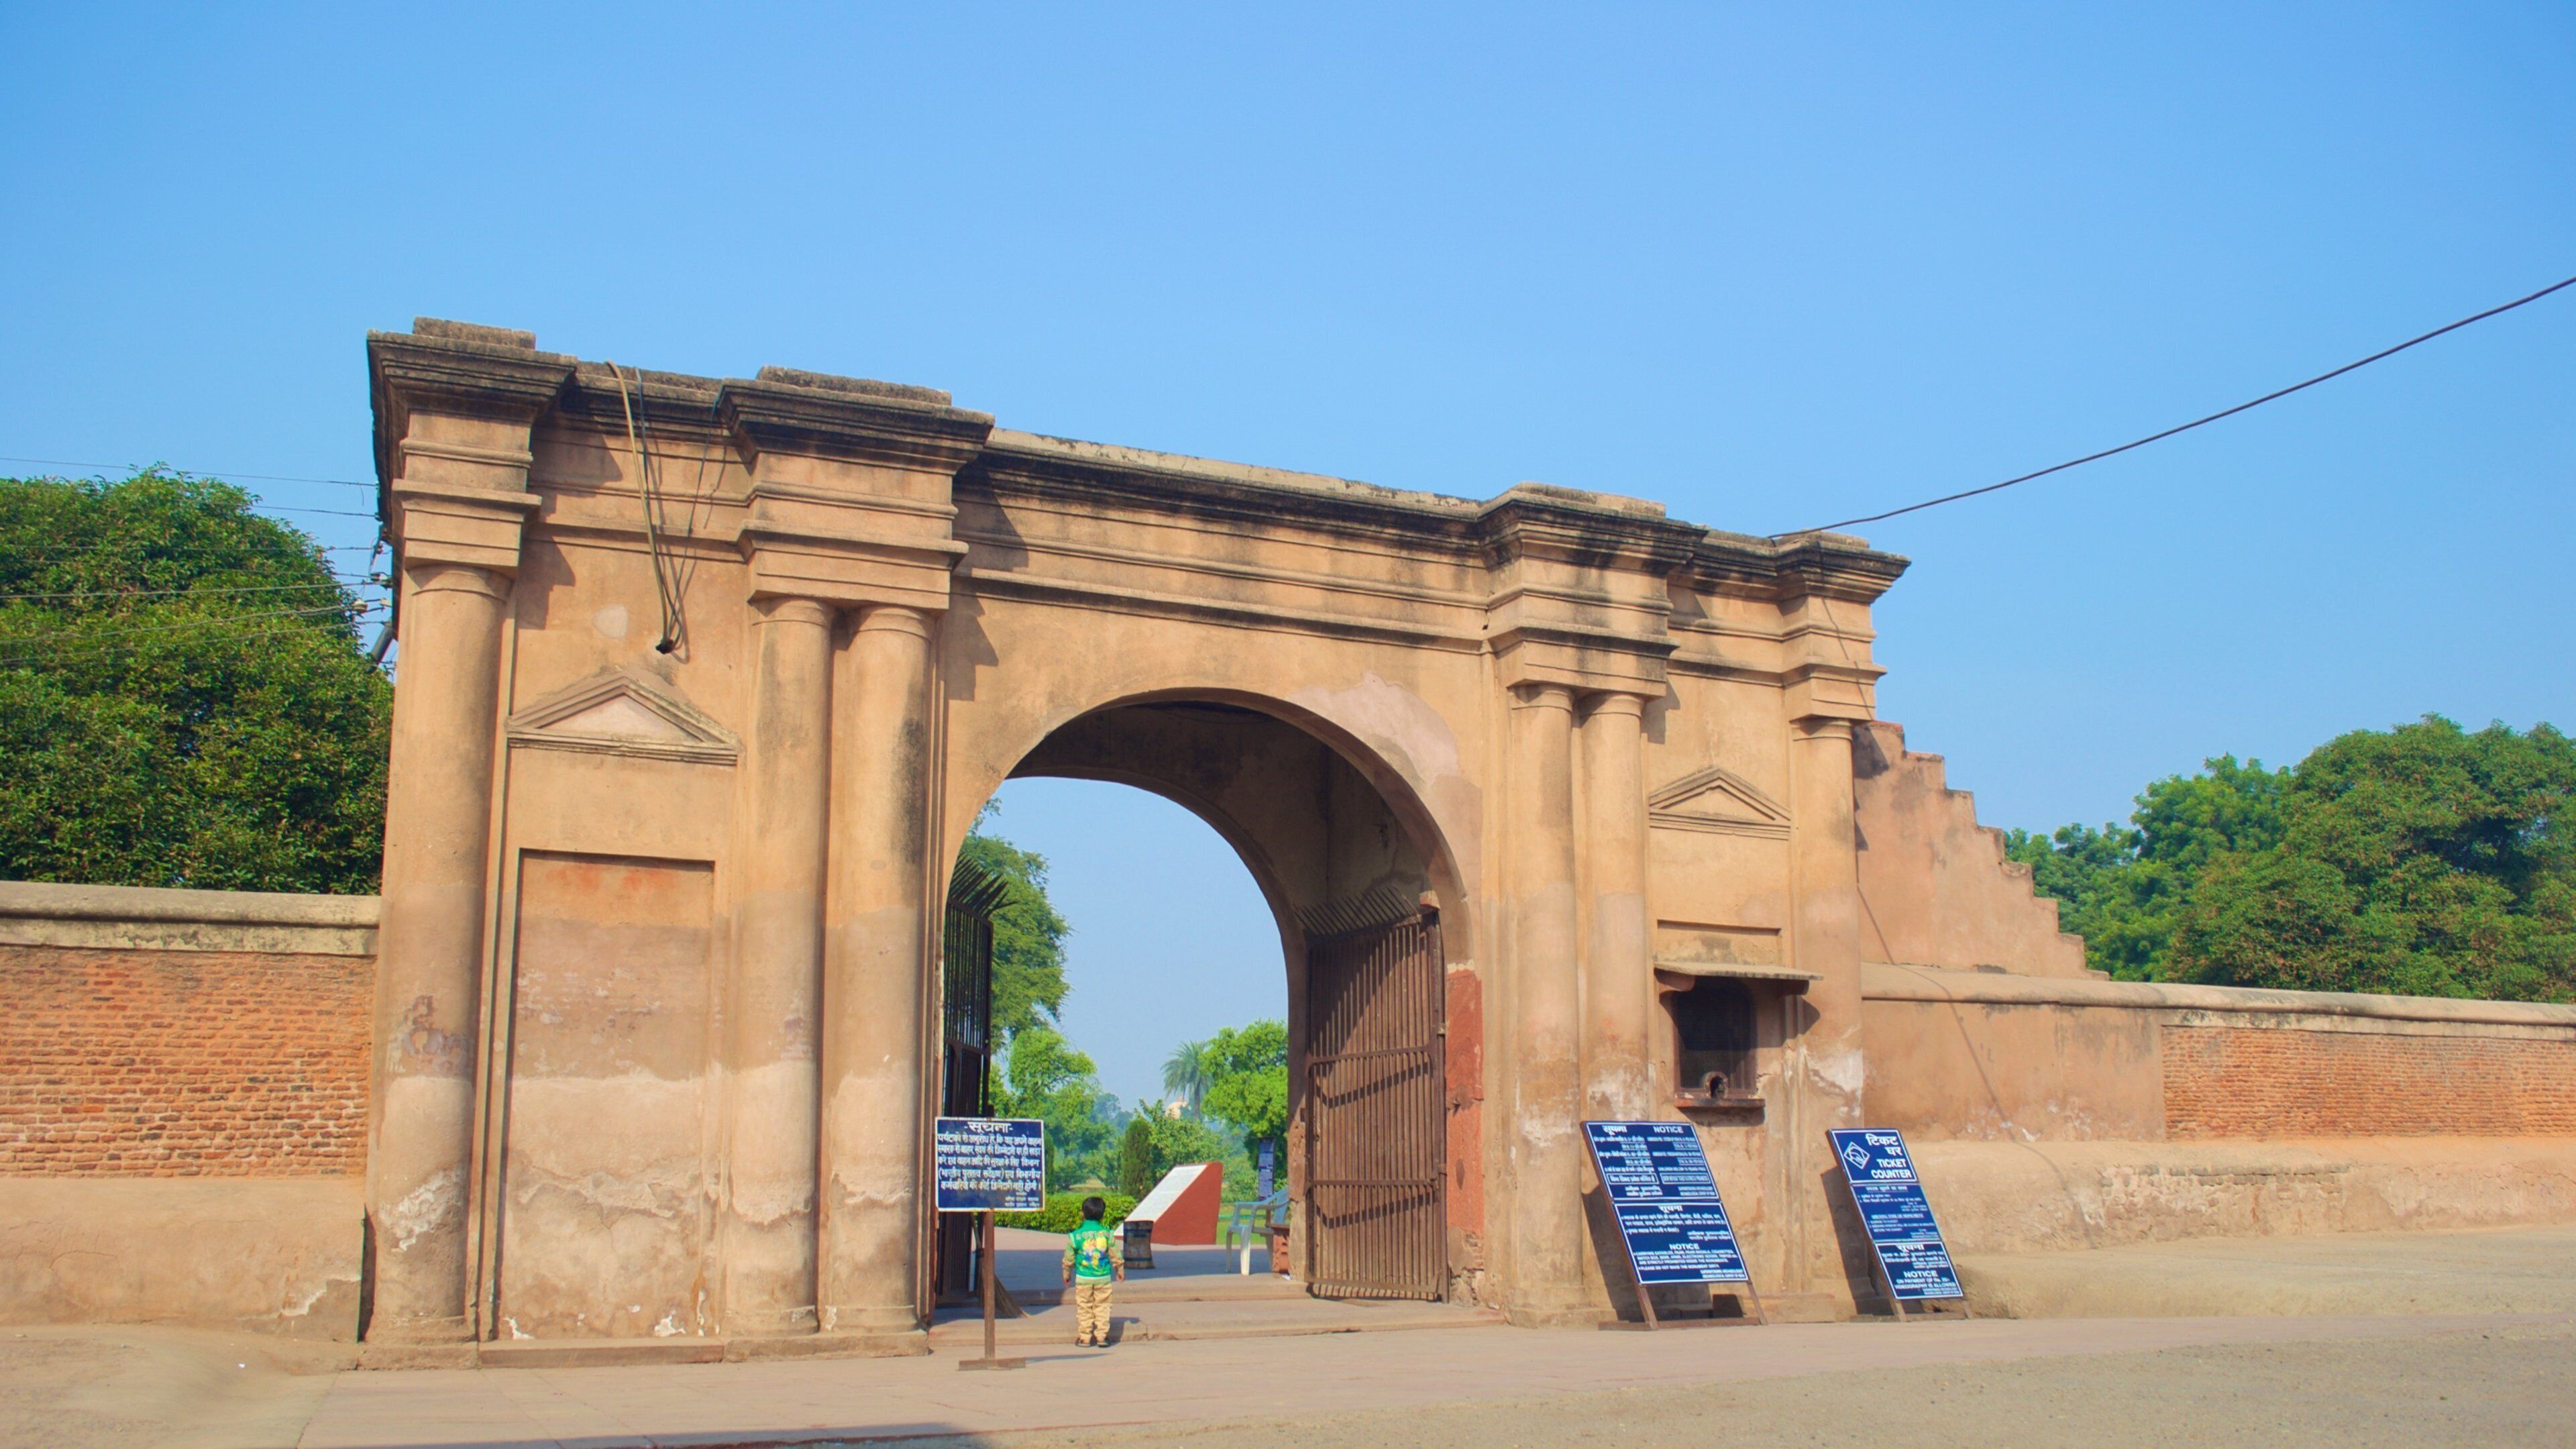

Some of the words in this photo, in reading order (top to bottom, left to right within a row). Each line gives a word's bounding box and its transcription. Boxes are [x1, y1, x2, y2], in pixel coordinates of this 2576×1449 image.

[1653, 1126, 1684, 1134] NOTICE
[1865, 1133, 1898, 1146] टिकट
[1884, 1146, 1902, 1156] घर
[1876, 1159, 1907, 1167] TICKET
[1871, 1169, 1913, 1179] COUNTER
[1903, 1270, 1939, 1278] NOTICE
